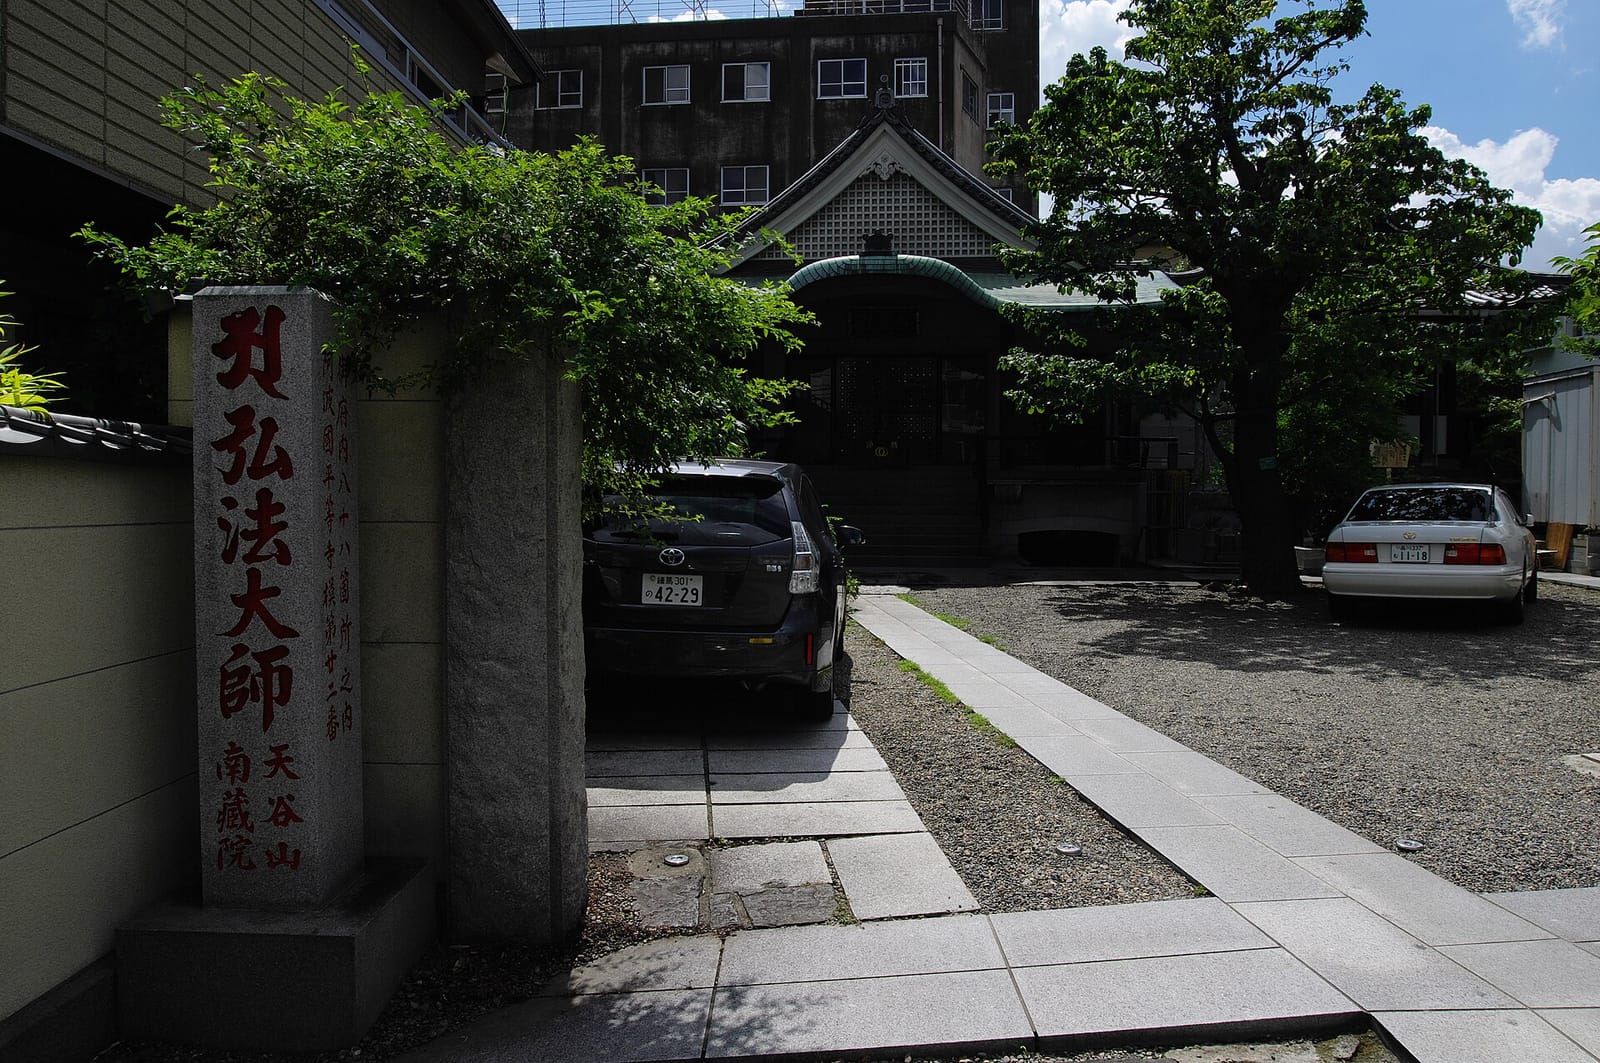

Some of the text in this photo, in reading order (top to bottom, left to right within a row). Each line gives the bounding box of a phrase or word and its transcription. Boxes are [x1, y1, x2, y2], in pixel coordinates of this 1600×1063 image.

[655, 587, 699, 603] 42-29
[260, 743, 304, 870] 天谷山
